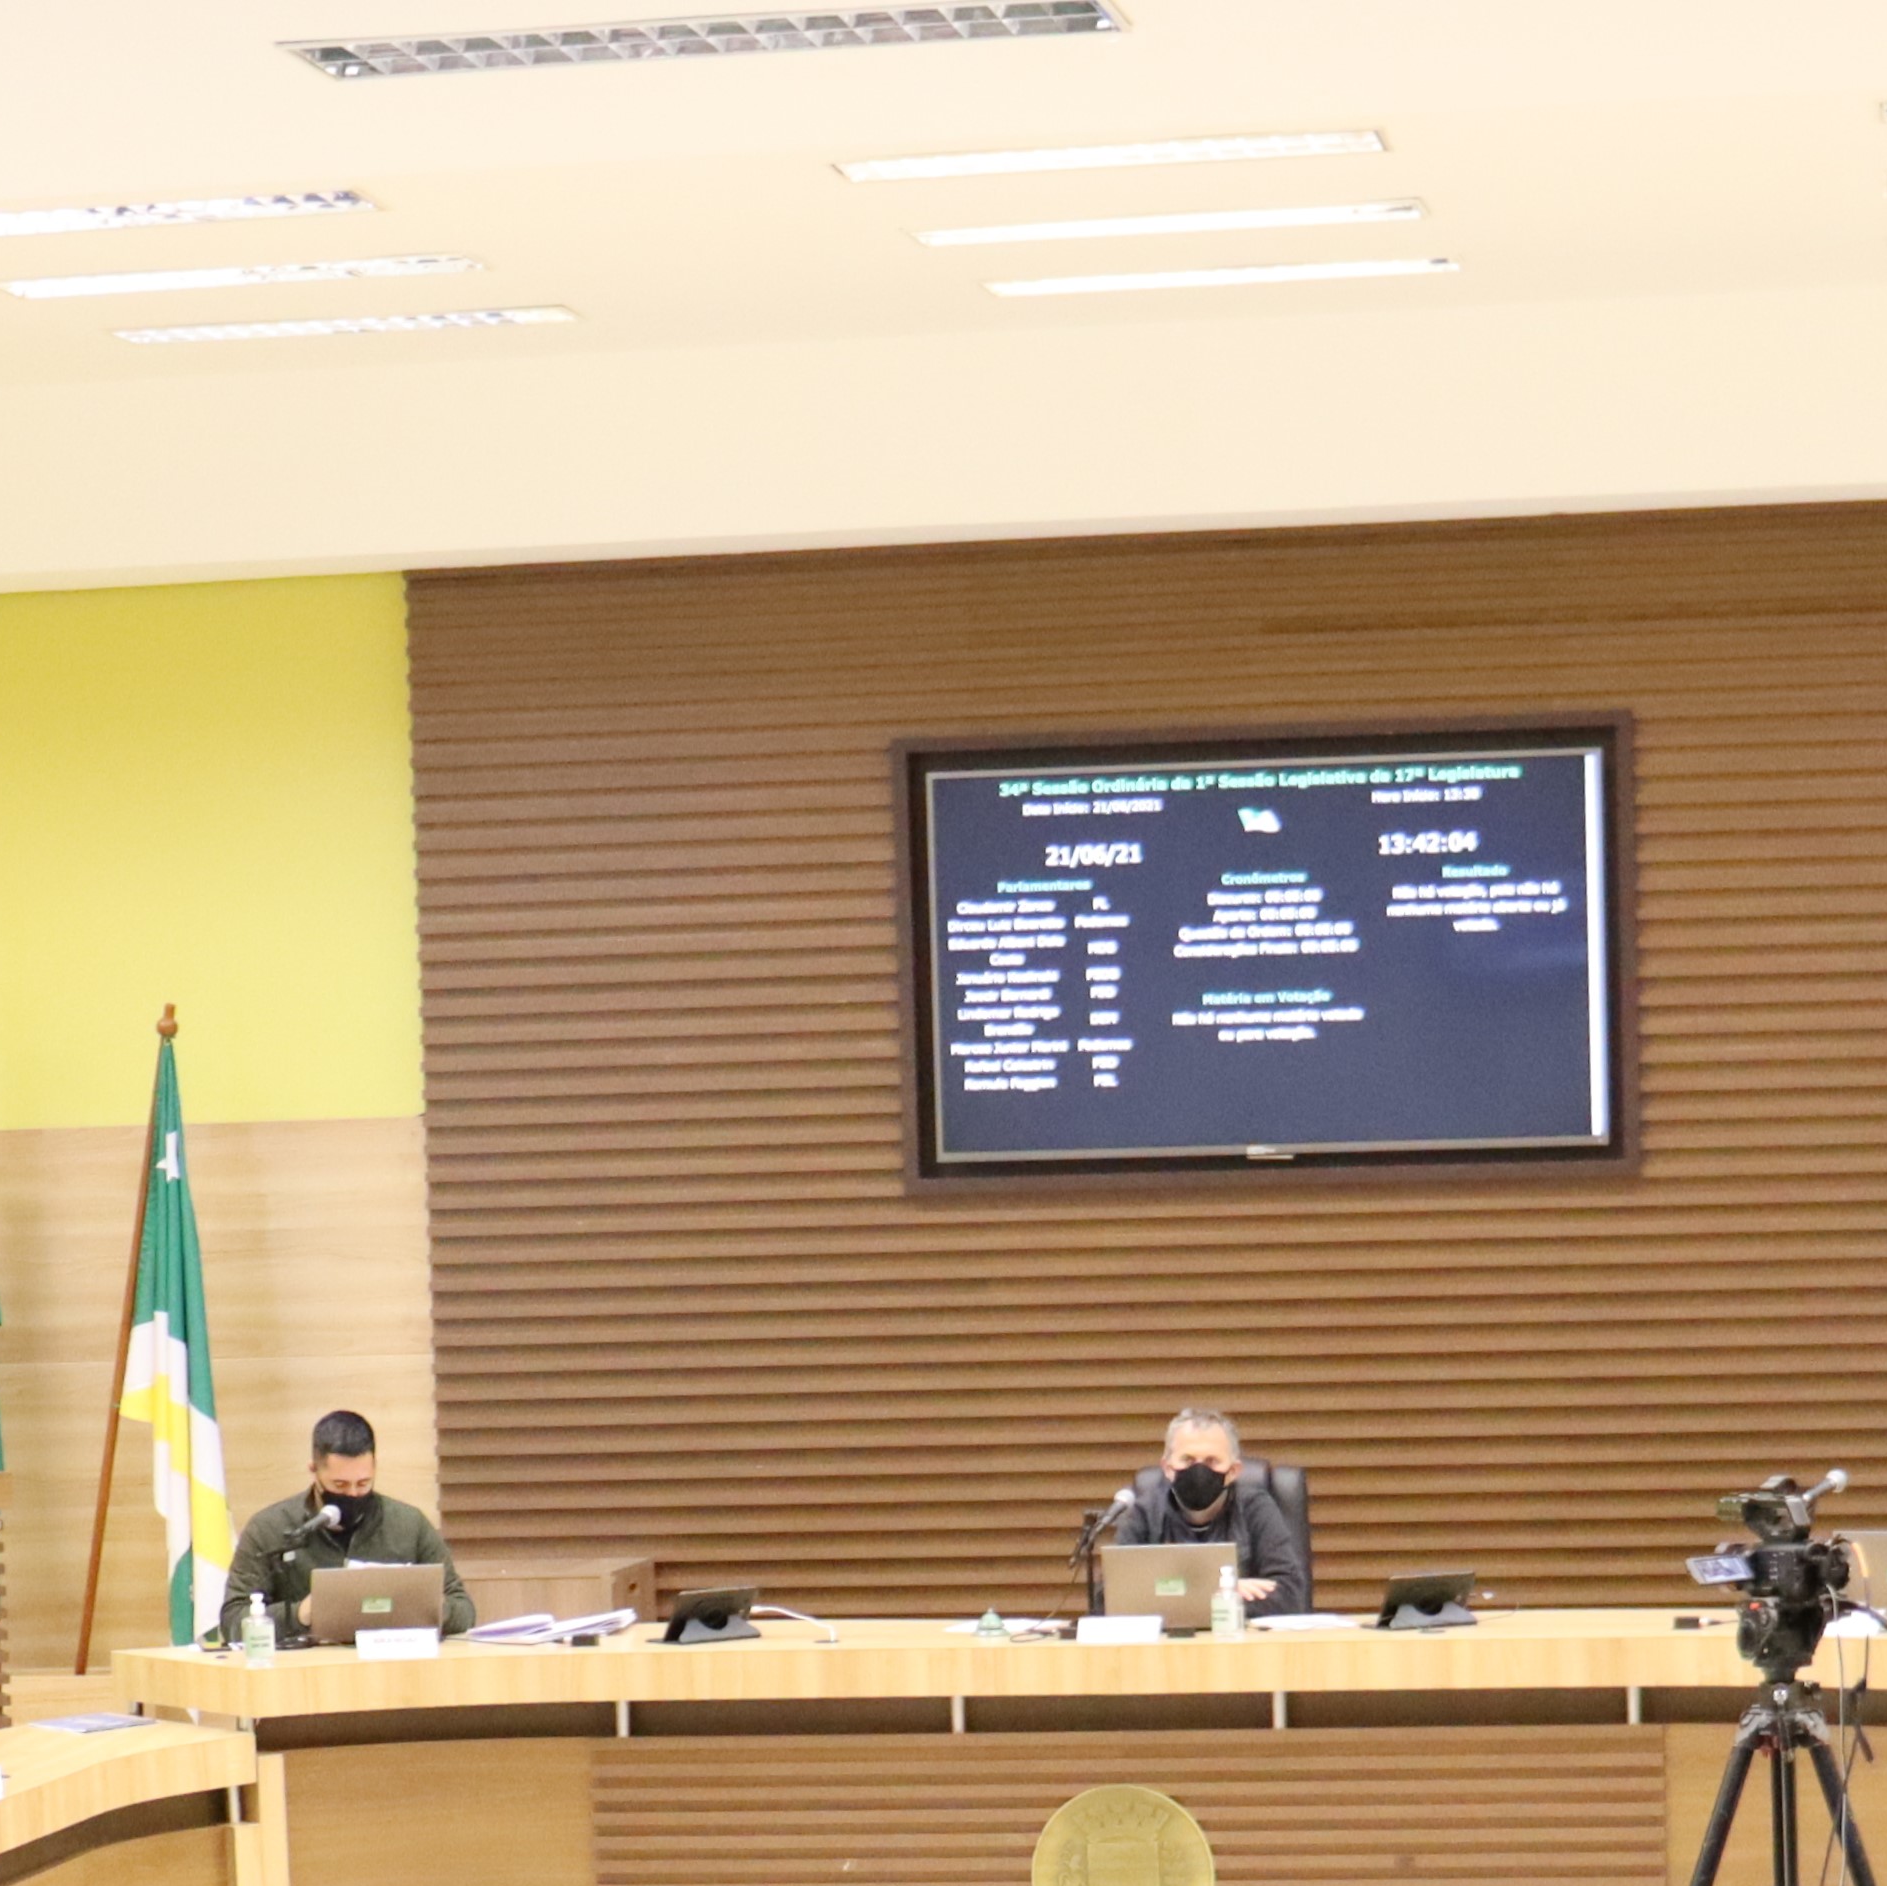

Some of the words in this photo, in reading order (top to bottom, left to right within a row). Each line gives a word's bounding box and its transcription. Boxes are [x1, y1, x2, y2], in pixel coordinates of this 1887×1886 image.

[1379, 831, 1479, 855] 13:42:04
[1045, 843, 1143, 868] 21/06/21
[1442, 865, 1507, 877] Resultado
[1222, 873, 1305, 885] Cronômetros
[998, 881, 1090, 892] Parlamentares
